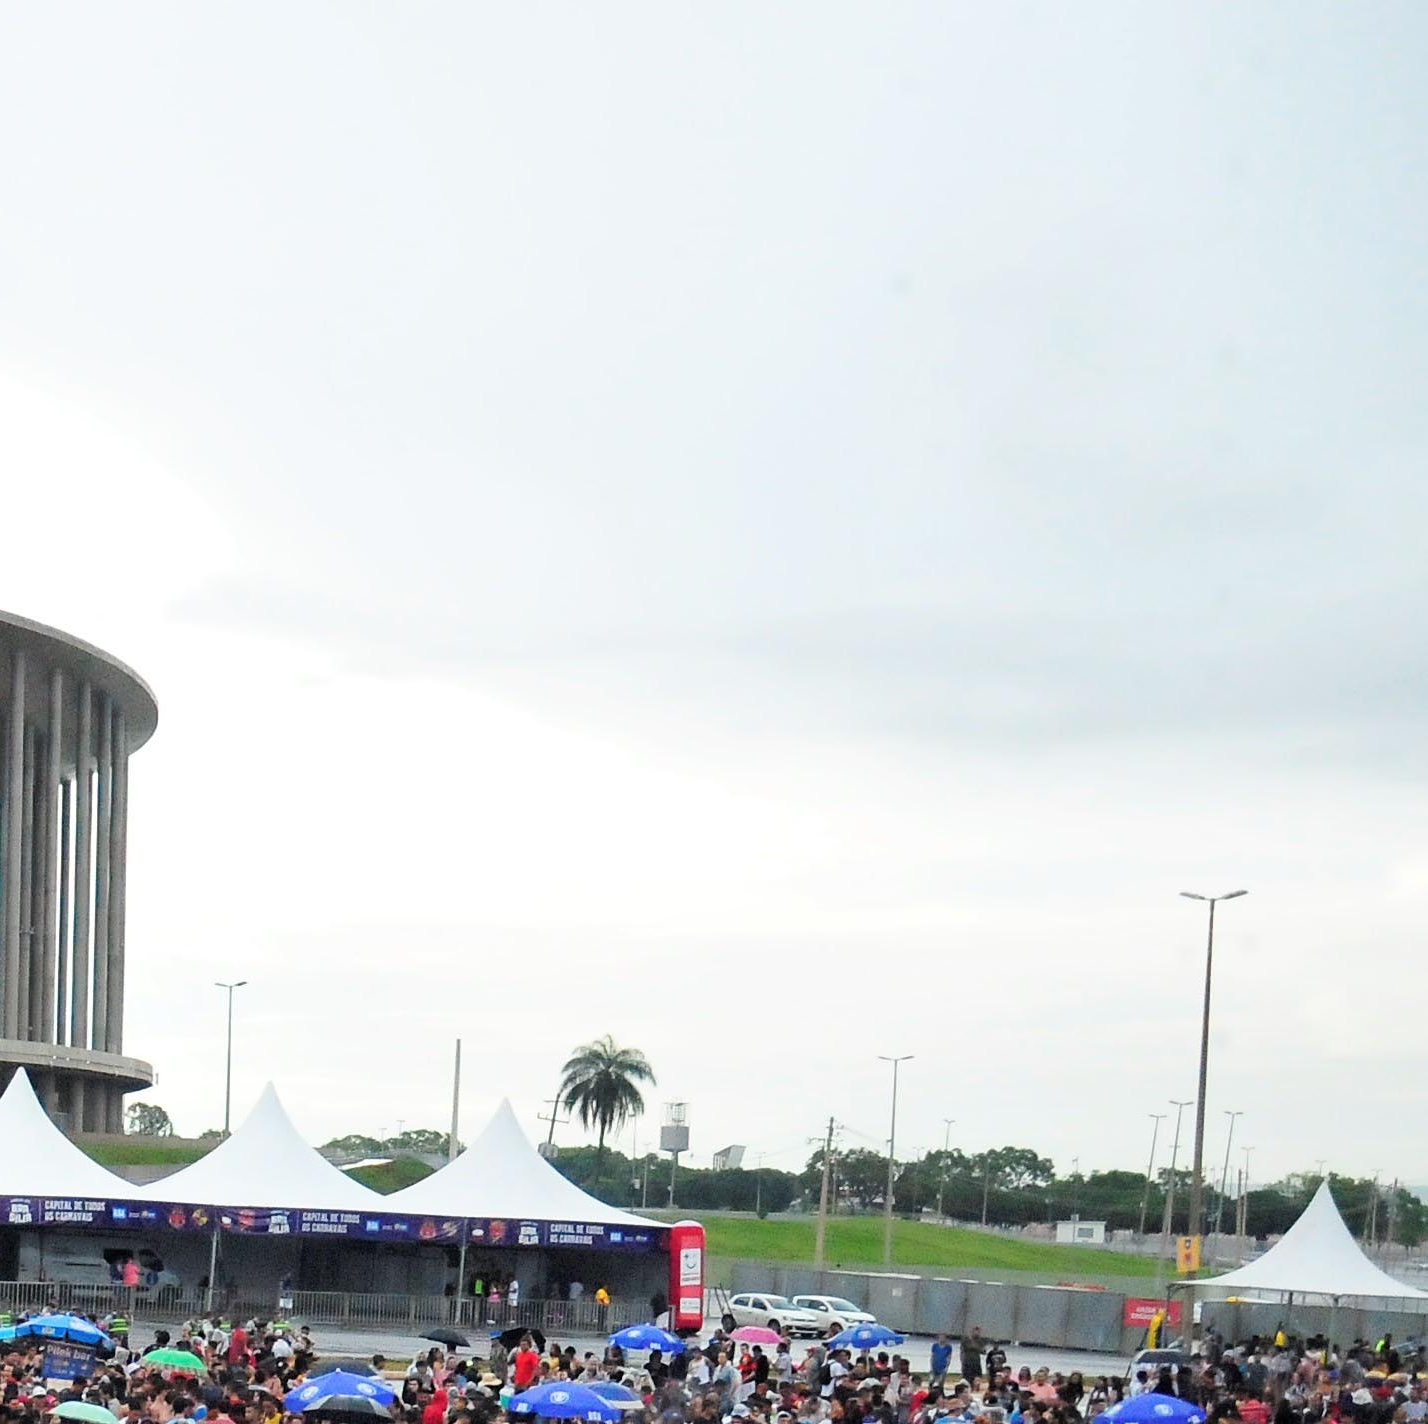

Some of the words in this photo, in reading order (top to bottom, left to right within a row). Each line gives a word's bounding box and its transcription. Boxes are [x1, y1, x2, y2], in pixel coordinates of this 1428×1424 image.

[44, 1199, 72, 1210] CAPITAL
[73, 1201, 83, 1211] DE
[84, 1201, 105, 1212] TODOS
[44, 1211, 54, 1222] OS
[55, 1211, 93, 1222] CARNAVAIS
[302, 1212, 329, 1223] CAPITAL
[330, 1213, 339, 1223] DE
[340, 1214, 360, 1224] TODOS
[302, 1222, 310, 1232] OS
[311, 1222, 348, 1233] CARNAVAIS
[550, 1223, 575, 1234] CAPITAL
